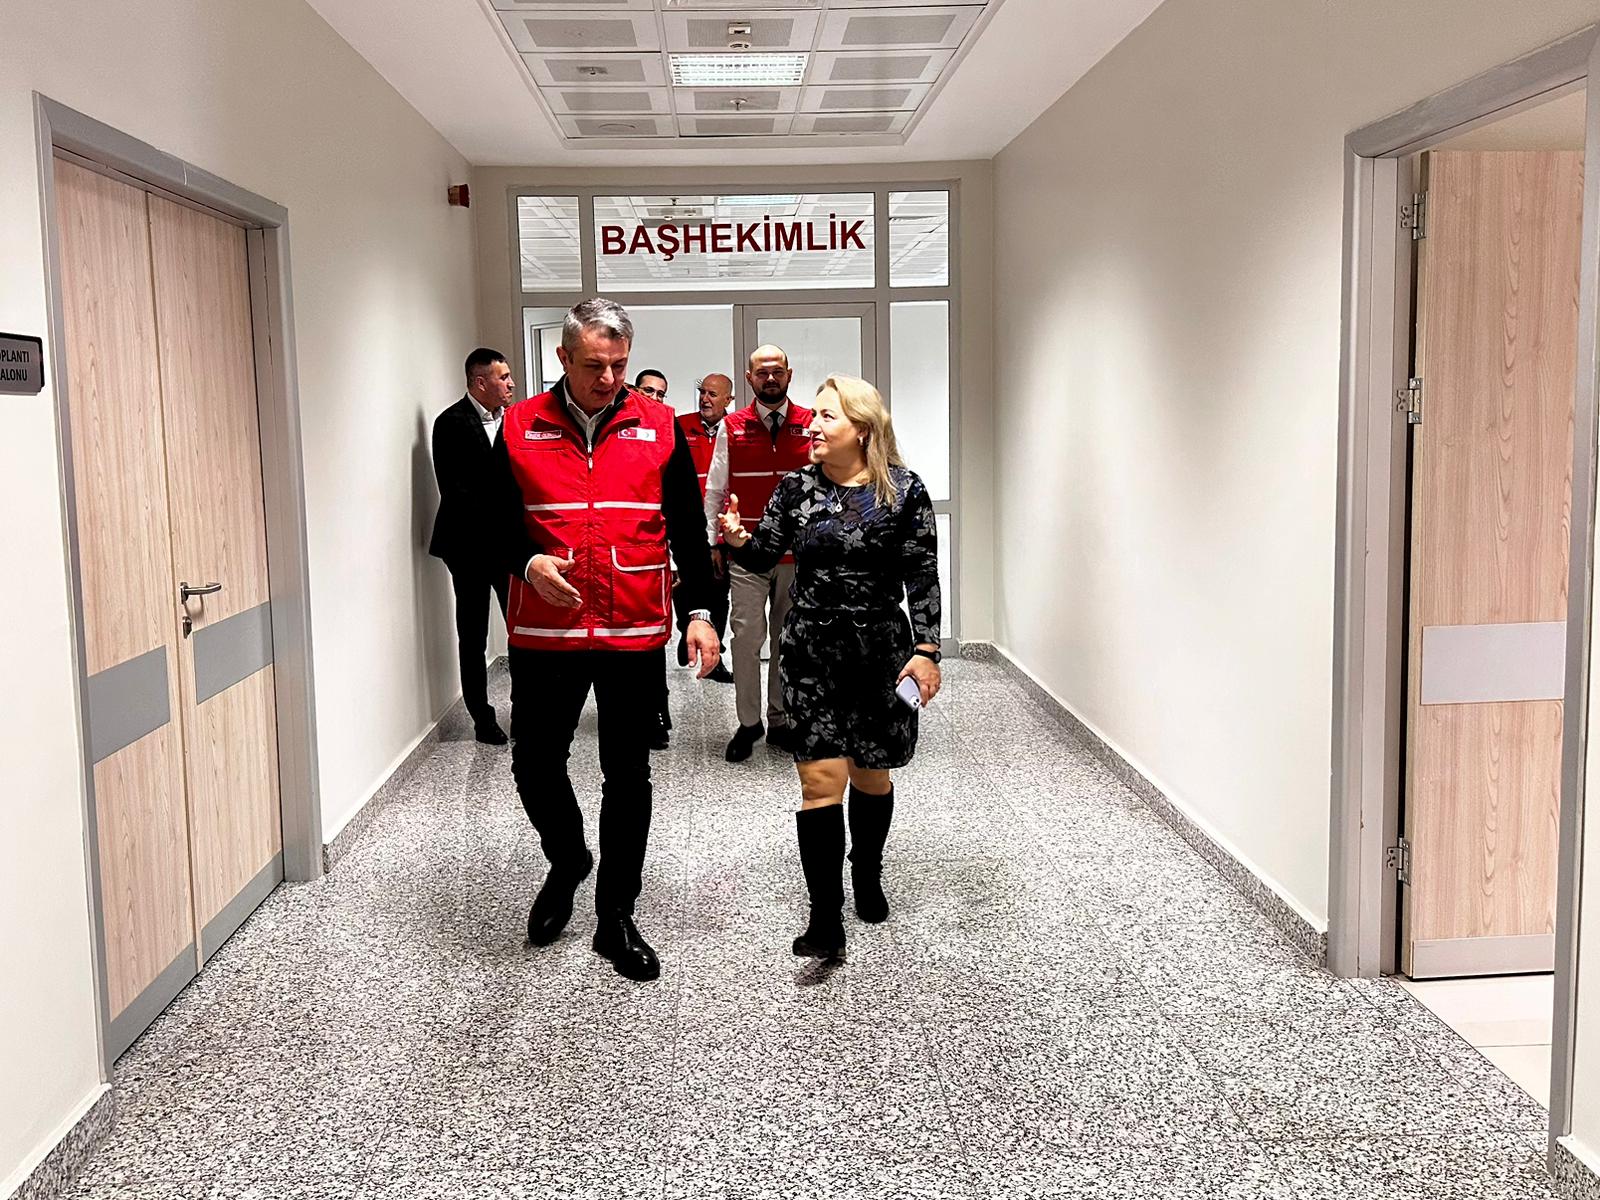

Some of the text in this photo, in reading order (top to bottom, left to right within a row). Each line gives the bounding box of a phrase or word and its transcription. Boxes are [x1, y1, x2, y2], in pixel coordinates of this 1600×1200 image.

[601, 213, 866, 261] BAŞHEKİMLİK
[0, 349, 30, 363] PLANTI
[0, 368, 28, 381] ALONU
